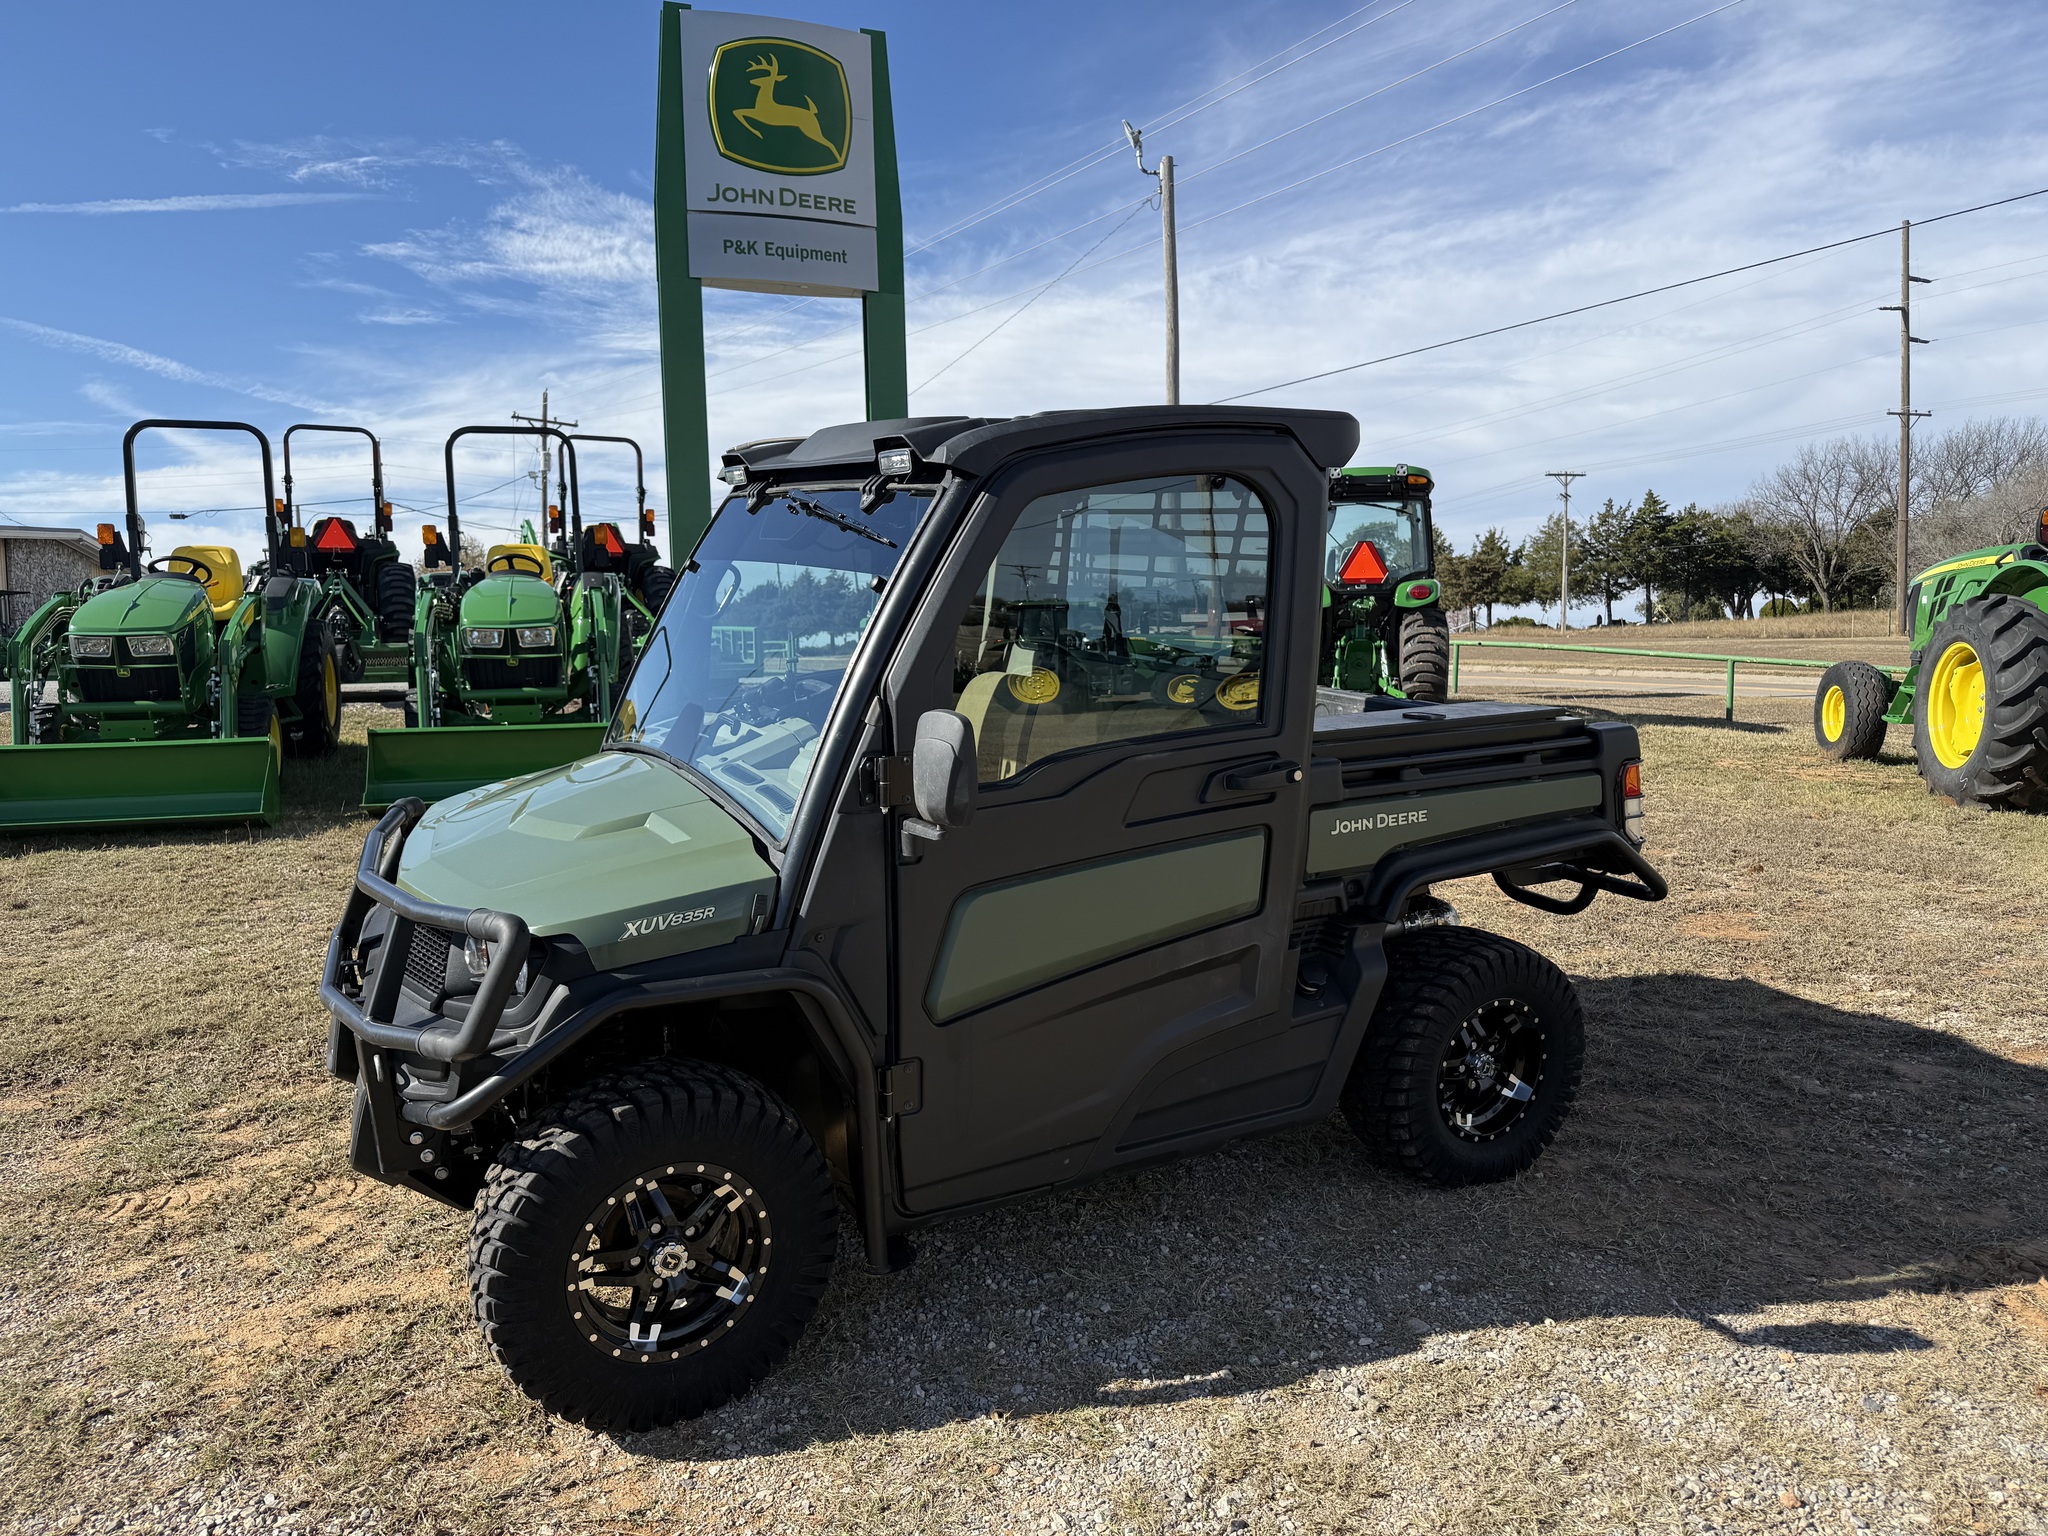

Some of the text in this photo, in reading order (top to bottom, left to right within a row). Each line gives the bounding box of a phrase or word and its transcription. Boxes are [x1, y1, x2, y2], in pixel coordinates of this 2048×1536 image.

[707, 183, 857, 215] JOHN DEERE
[723, 239, 848, 264] P&K Equipment
[1330, 809, 1428, 836] JOHN DEERE
